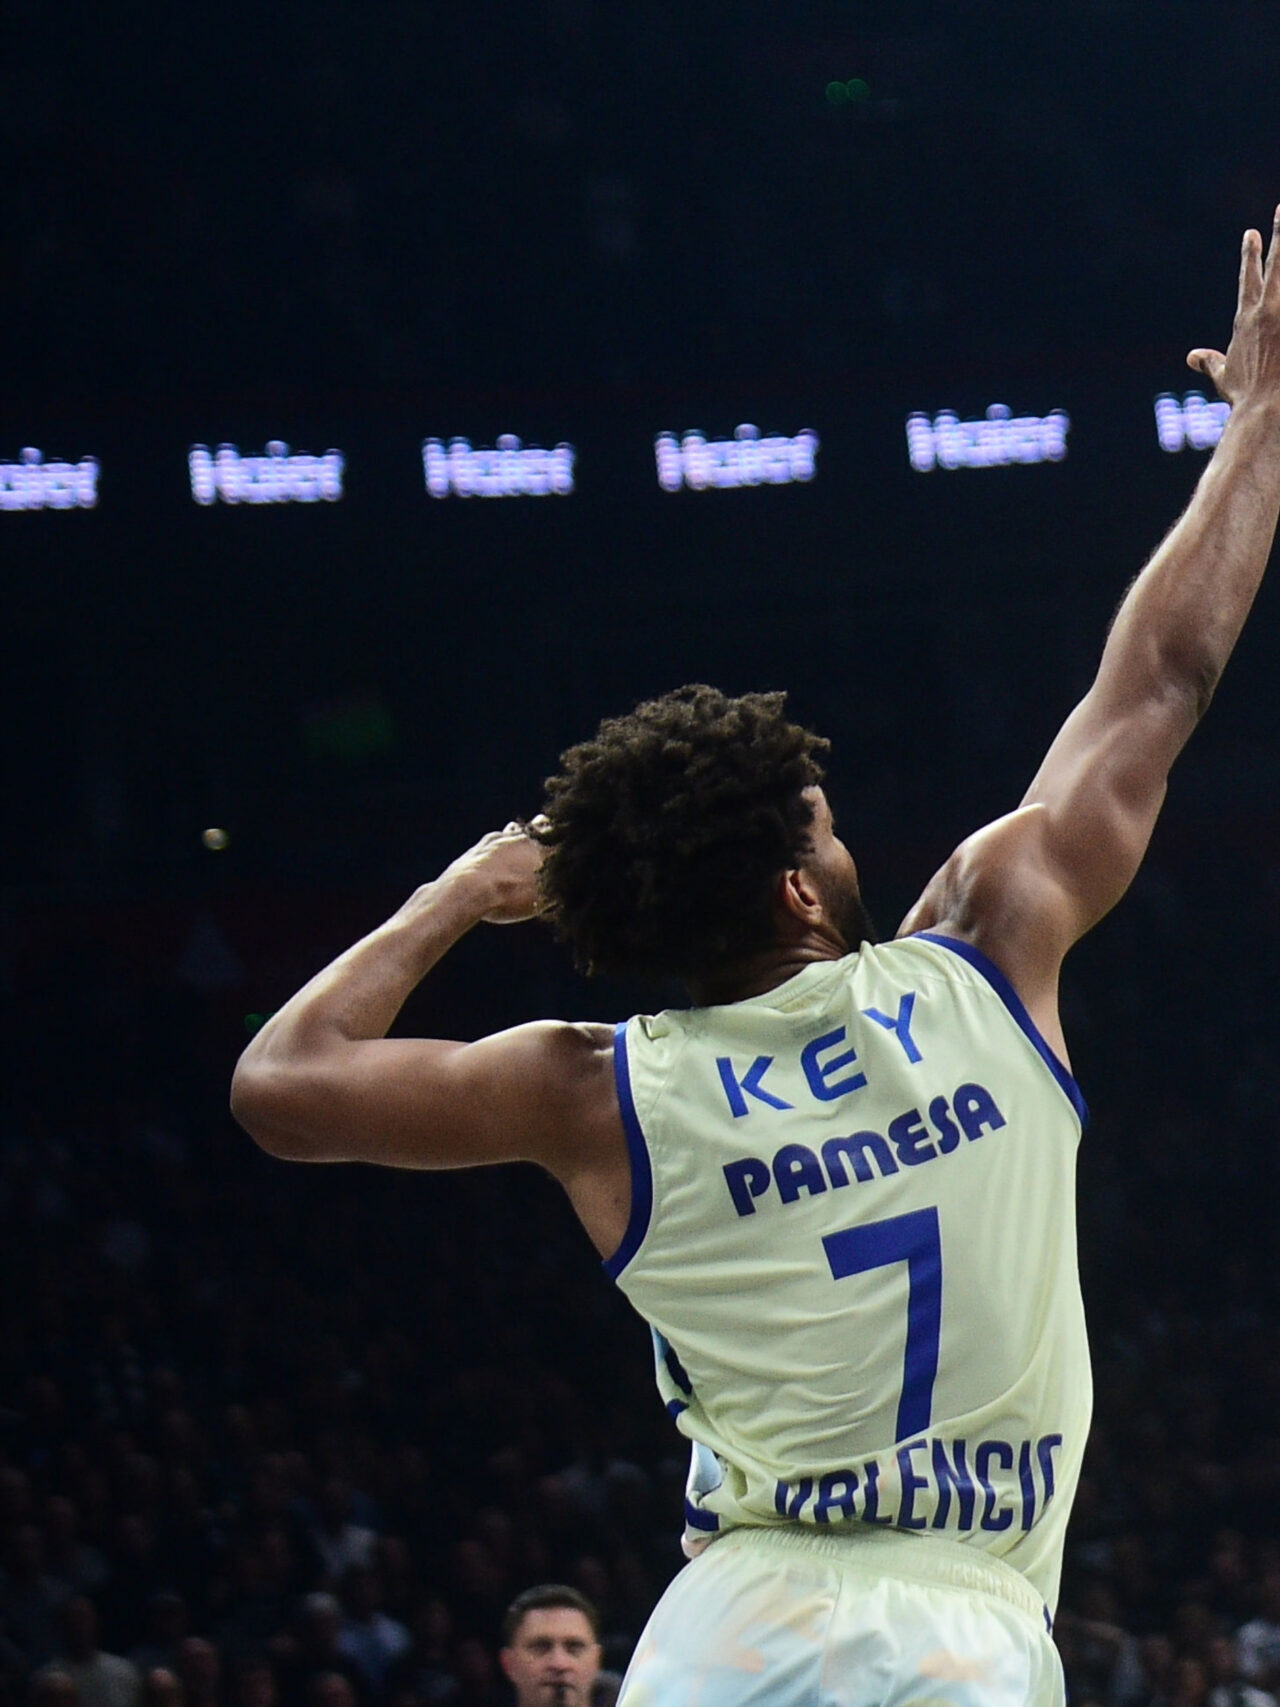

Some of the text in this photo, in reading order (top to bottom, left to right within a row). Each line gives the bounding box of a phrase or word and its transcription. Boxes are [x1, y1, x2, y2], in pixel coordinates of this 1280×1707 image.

[717, 992, 925, 1119] KEY
[722, 1083, 1007, 1217] PAMESA
[822, 1205, 943, 1444] 7
